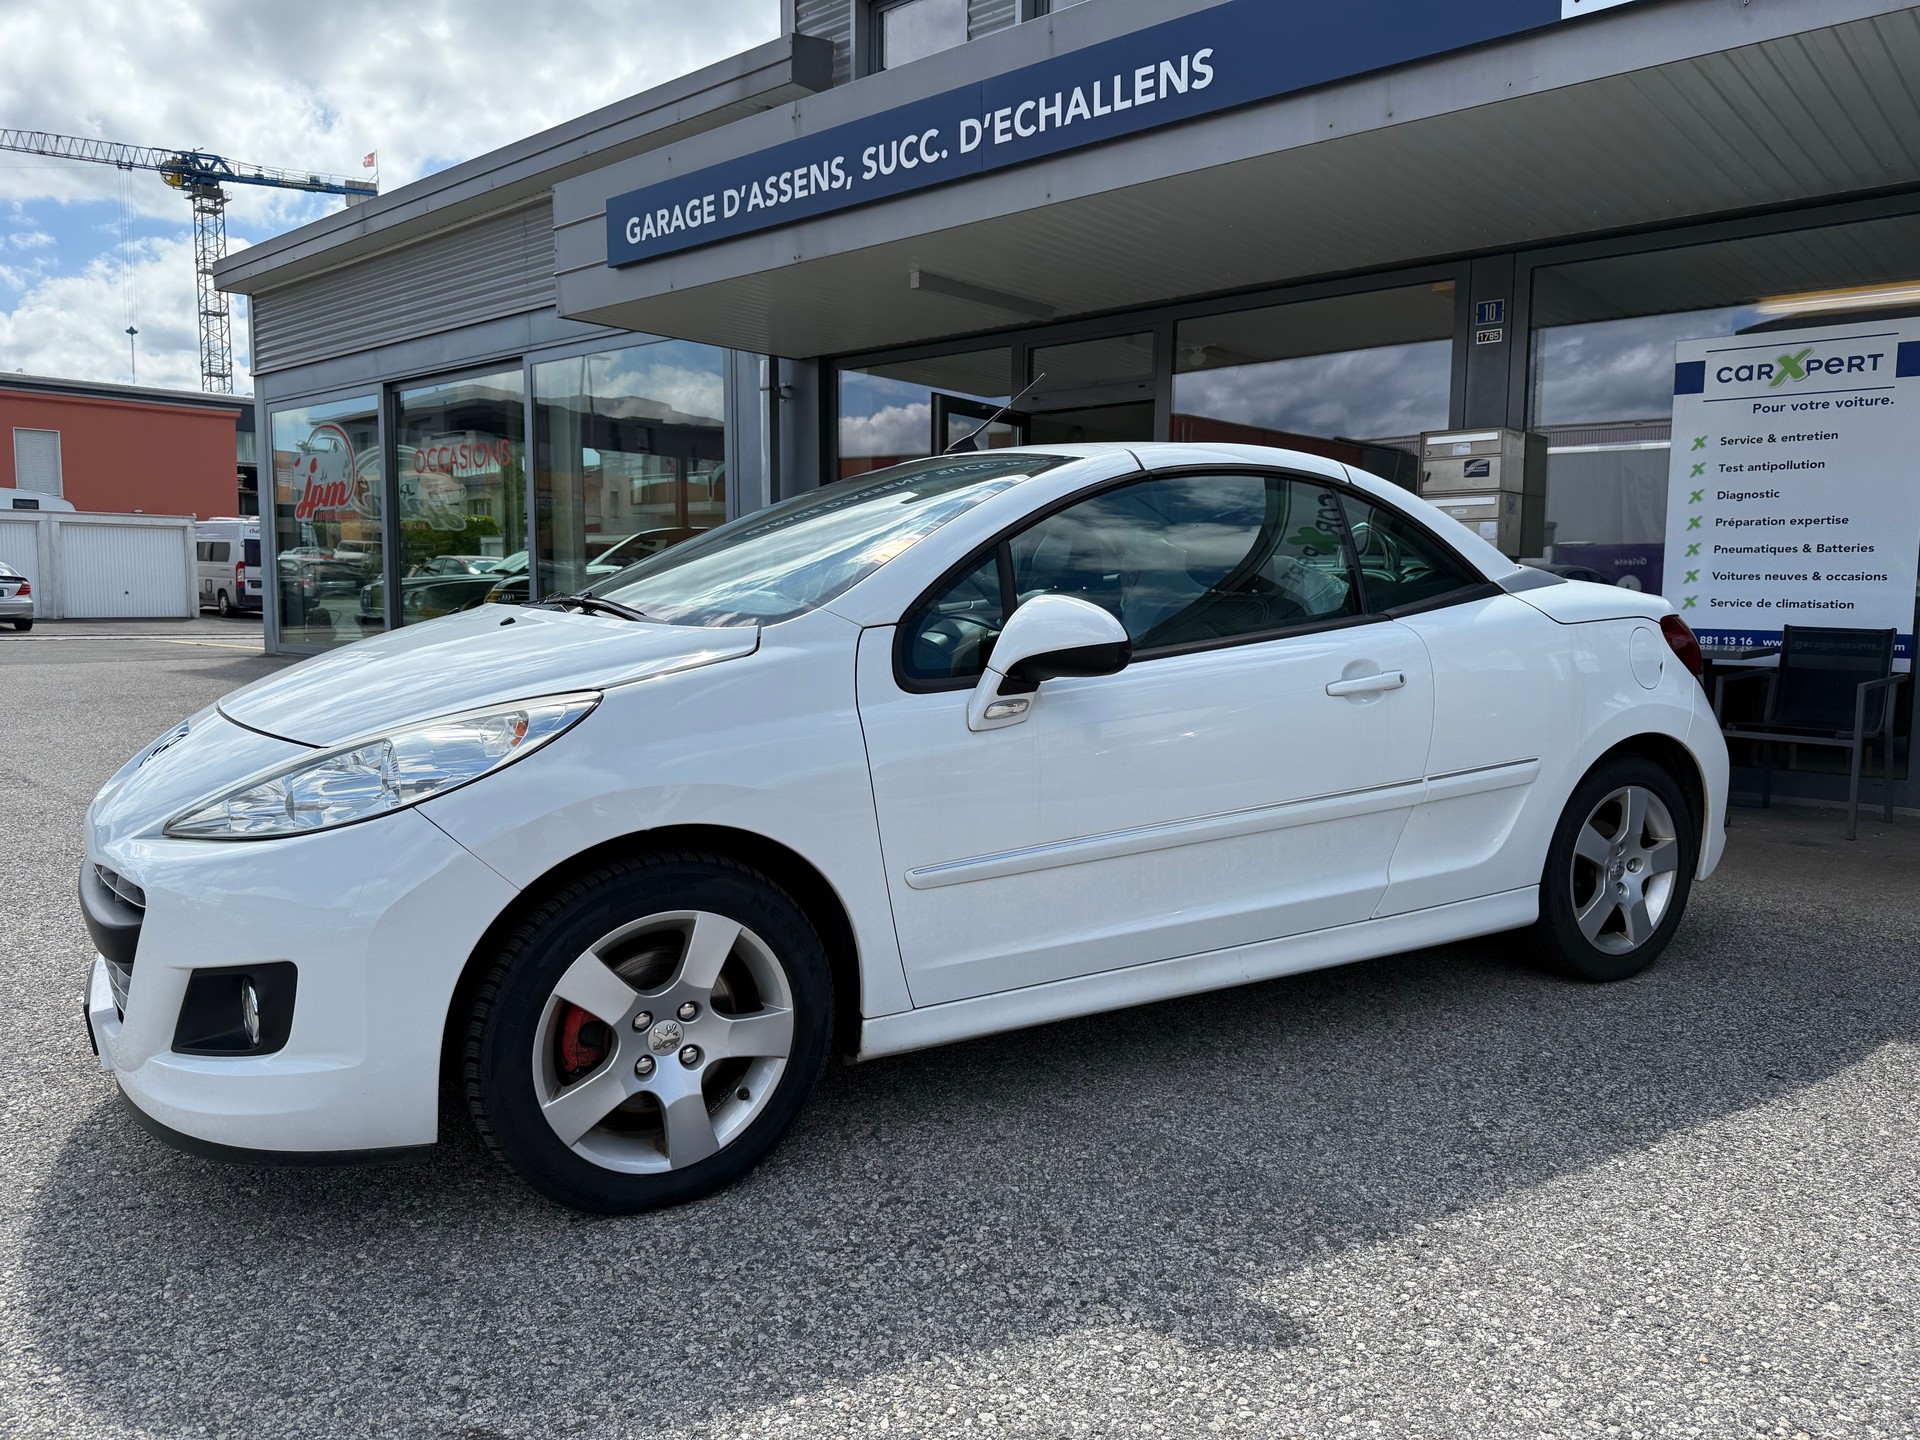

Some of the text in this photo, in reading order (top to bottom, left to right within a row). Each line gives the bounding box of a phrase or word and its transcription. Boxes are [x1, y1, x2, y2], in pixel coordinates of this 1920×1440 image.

[625, 48, 1214, 245] GARAGE D'ASSENS, SUCC. D'ECHALLENS
[1484, 303, 1496, 321] 10
[1480, 332, 1499, 341] 1785
[1752, 395, 1895, 414] Pour votre voiture.
[1720, 431, 1839, 446] Service & entretien
[413, 438, 511, 474] OCCASIONS
[1719, 460, 1826, 474] Test antipollution
[1717, 489, 1780, 502] Diagnostic
[1715, 515, 1850, 528] Préparation expertise
[1713, 542, 1875, 556] Pneumatiques & Batteries
[1711, 571, 1888, 581] Voitures neuves & occasions
[1710, 598, 1855, 610] Service de climatisation
[1700, 635, 1719, 645] 881
[1723, 636, 1736, 645] 13
[1739, 636, 1753, 646] 16
